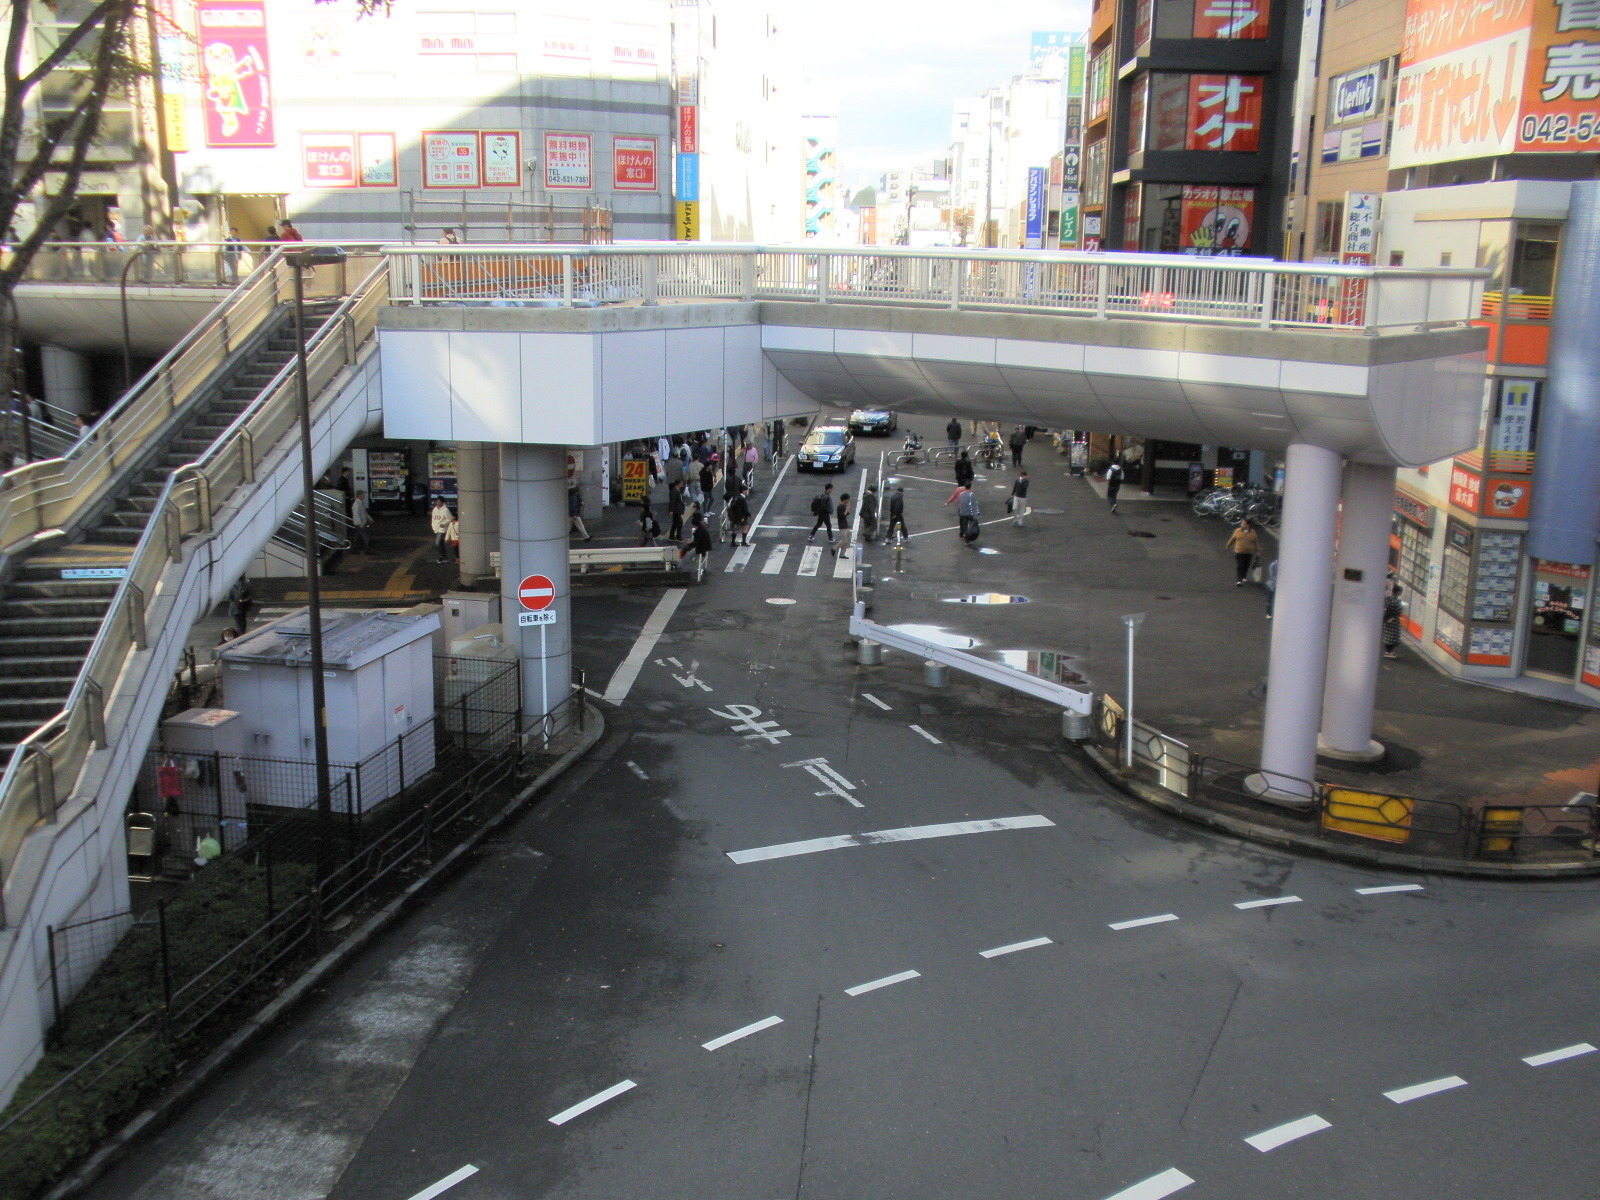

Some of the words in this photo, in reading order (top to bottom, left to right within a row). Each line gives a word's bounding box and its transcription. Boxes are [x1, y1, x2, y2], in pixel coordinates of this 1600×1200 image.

[421, 38, 444, 48] mini
[451, 38, 474, 48] mini
[614, 46, 632, 57] mini
[637, 48, 655, 59] mini
[684, 107, 692, 151] ほけんの窓口
[549, 140, 587, 151] 無料相談
[307, 151, 351, 162] ほけんの
[617, 155, 652, 166] ほけんの
[434, 164, 449, 172] 生命
[456, 164, 470, 172] 損害
[626, 168, 643, 179] 窓口
[548, 175, 589, 183] 042-521-7351
[1028, 169, 1038, 221] アパマンショップ
[1183, 188, 1254, 201] カラオケ歌広場
[683, 202, 692, 225] JEANS
[1064, 212, 1073, 238] レイク
[1347, 211, 1360, 252] 総合商社
[1359, 213, 1373, 252] 不動産
[1086, 239, 1098, 253] カ
[624, 462, 644, 478] 24
[625, 484, 645, 492] JEANS
[520, 613, 554, 624] 自転車を除く
